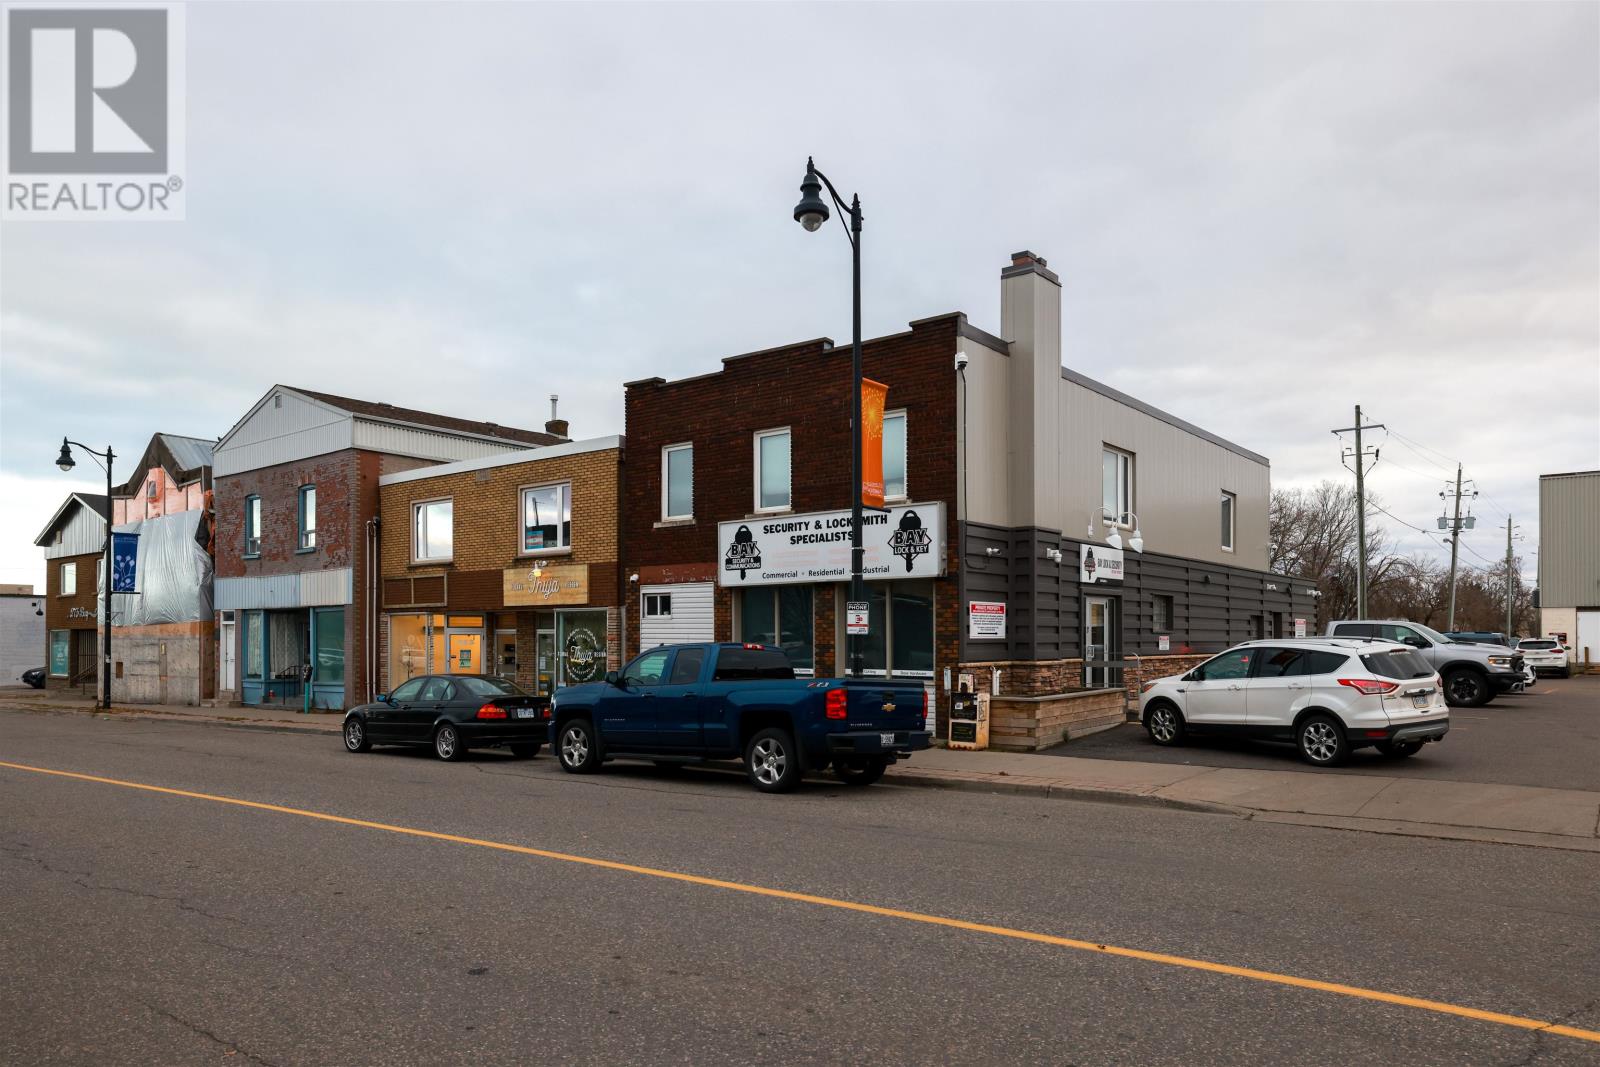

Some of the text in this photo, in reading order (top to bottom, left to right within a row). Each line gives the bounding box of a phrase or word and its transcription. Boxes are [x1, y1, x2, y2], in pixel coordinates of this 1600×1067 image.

[763, 514, 888, 534] SECURITY & LOCKMITH
[790, 531, 853, 545] SPECIALISTS
[894, 529, 927, 546] BAY
[730, 541, 757, 557] BAY
[894, 546, 909, 554] LOCK
[916, 545, 928, 553] KEY
[762, 571, 798, 580] Commercial
[808, 568, 845, 577] Residential
